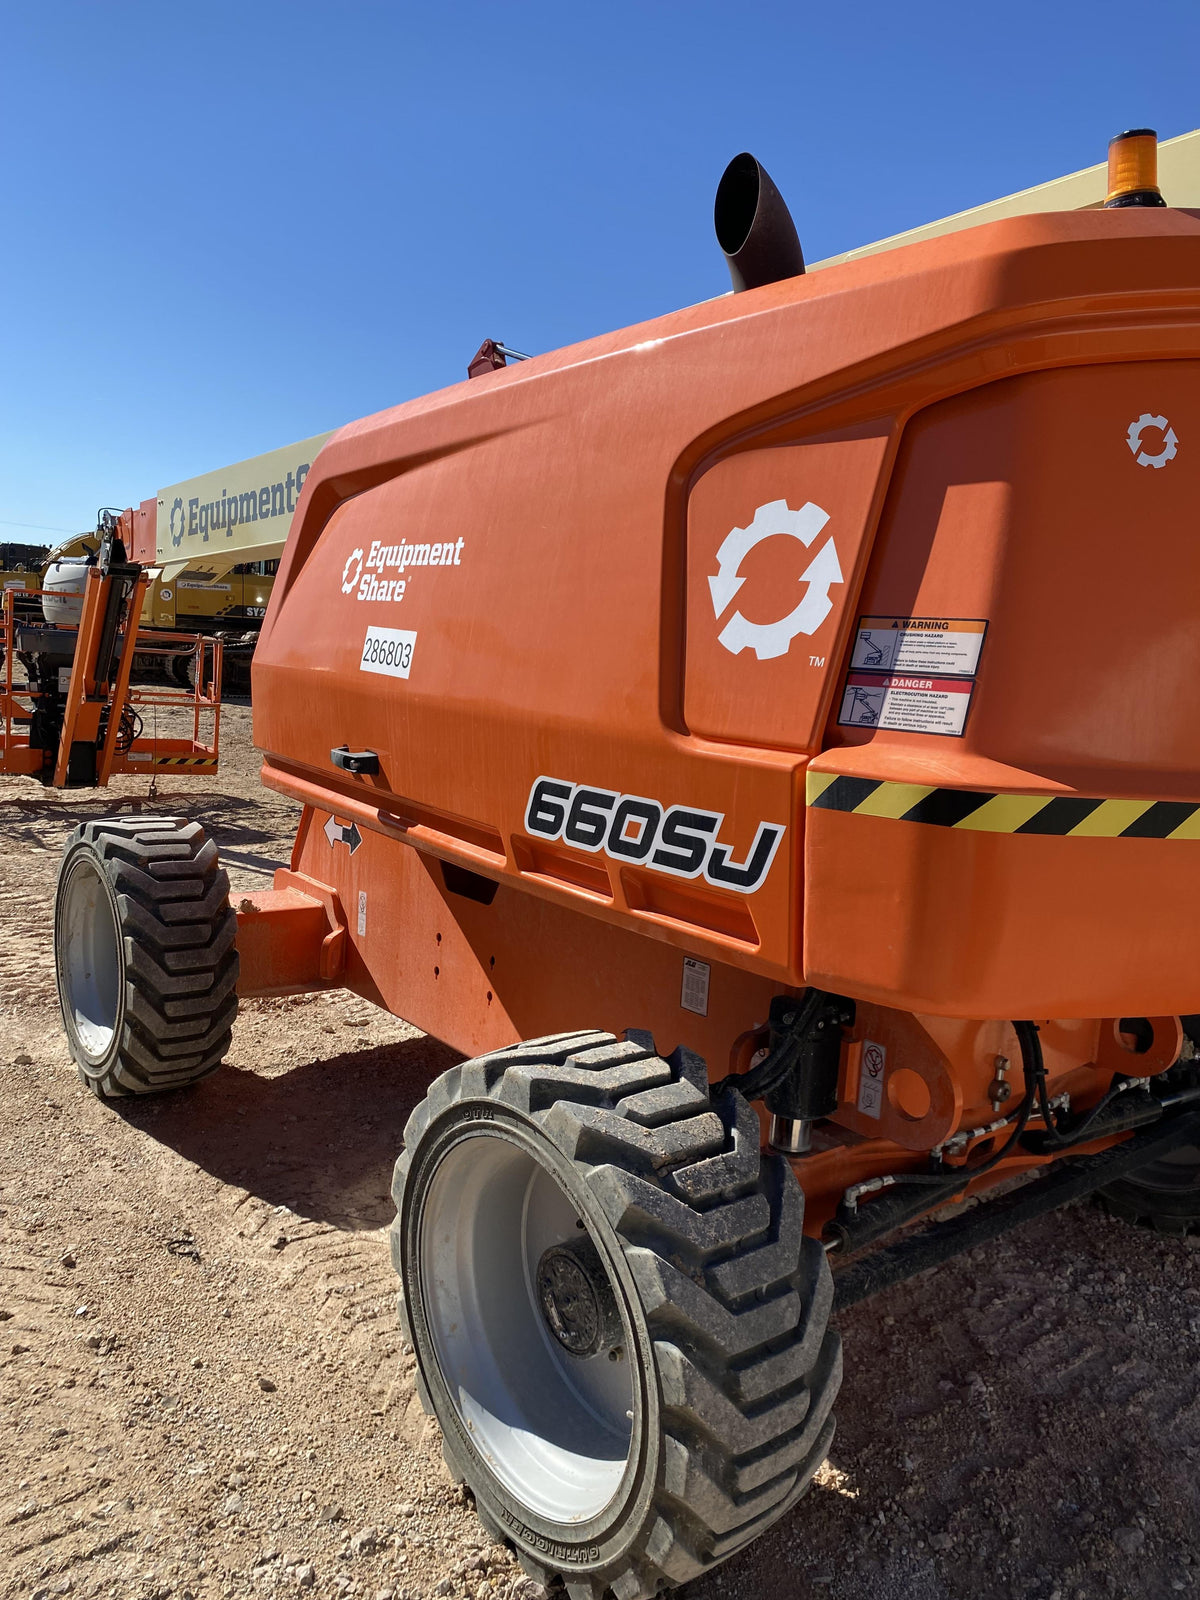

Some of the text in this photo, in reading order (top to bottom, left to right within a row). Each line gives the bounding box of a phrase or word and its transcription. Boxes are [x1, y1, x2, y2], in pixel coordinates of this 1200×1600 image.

[365, 536, 465, 573] Equipment
[357, 574, 406, 602] Share
[902, 620, 949, 631] WARNING
[362, 638, 412, 668] 286803
[808, 655, 826, 668] TM
[891, 679, 933, 689] DANGER
[526, 777, 784, 892] 660SJ
